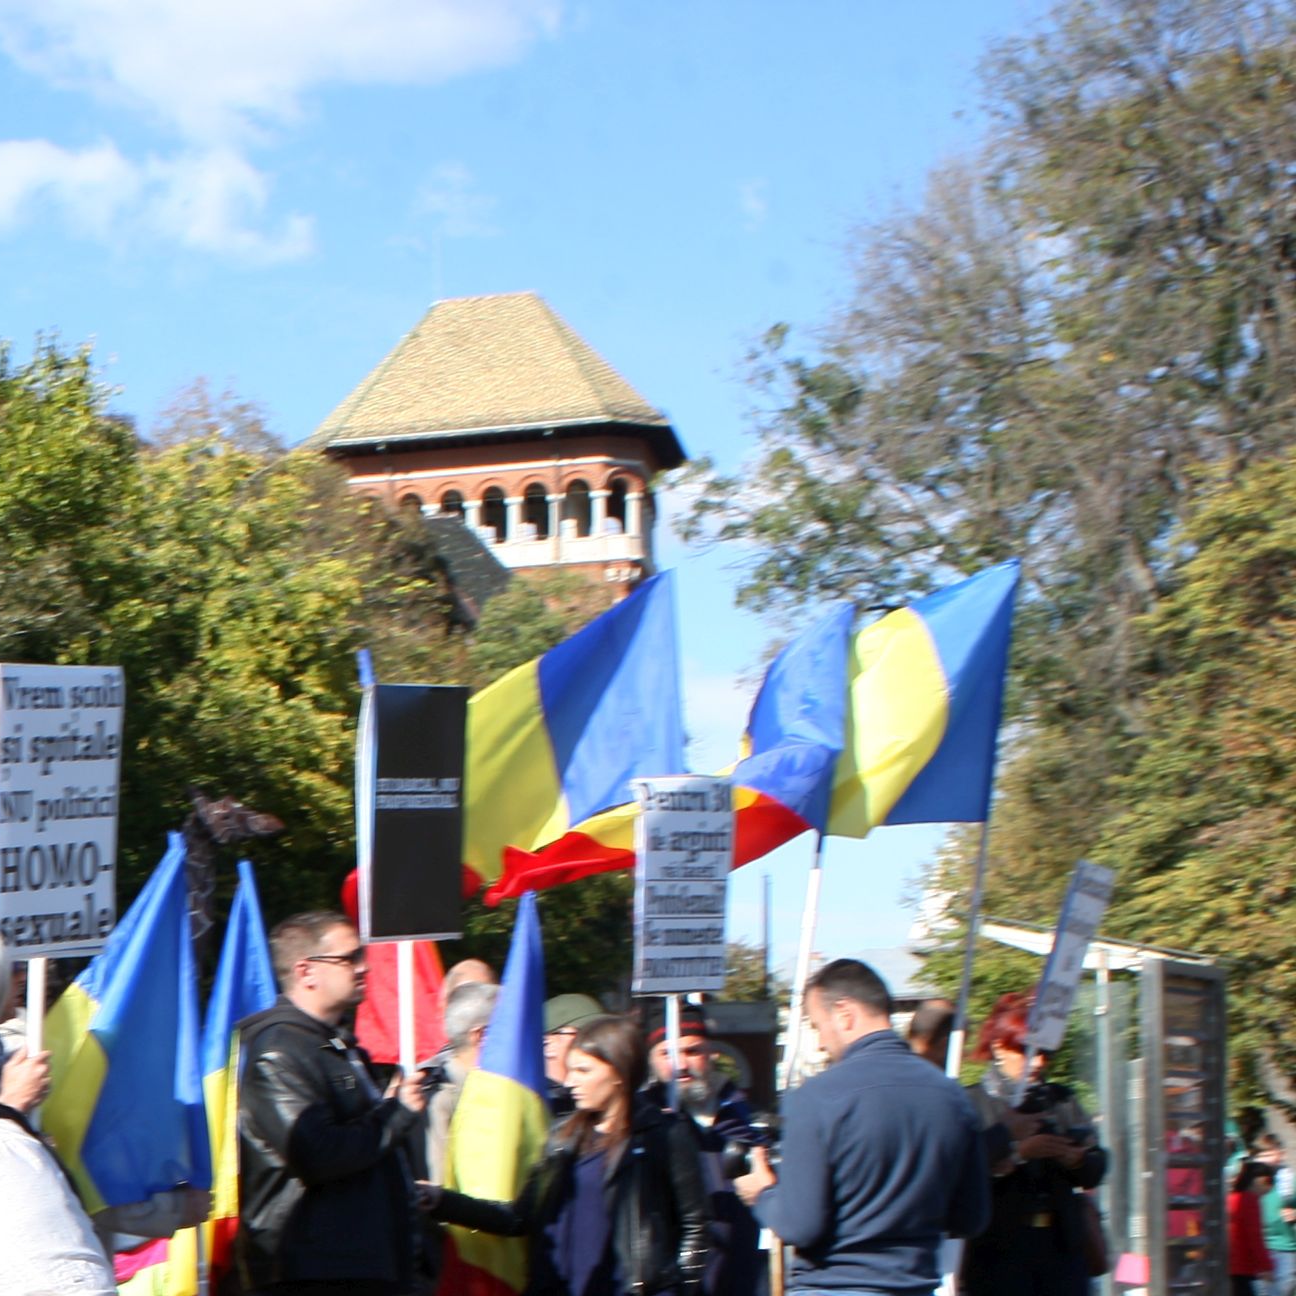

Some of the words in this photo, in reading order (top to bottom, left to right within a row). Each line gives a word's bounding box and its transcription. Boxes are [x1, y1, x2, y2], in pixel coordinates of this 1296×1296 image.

[2, 677, 65, 710] Vrem
[30, 719, 120, 776] spitale
[0, 789, 34, 824] NU
[0, 840, 114, 893] HOMO-
[0, 893, 114, 948] sexuale
